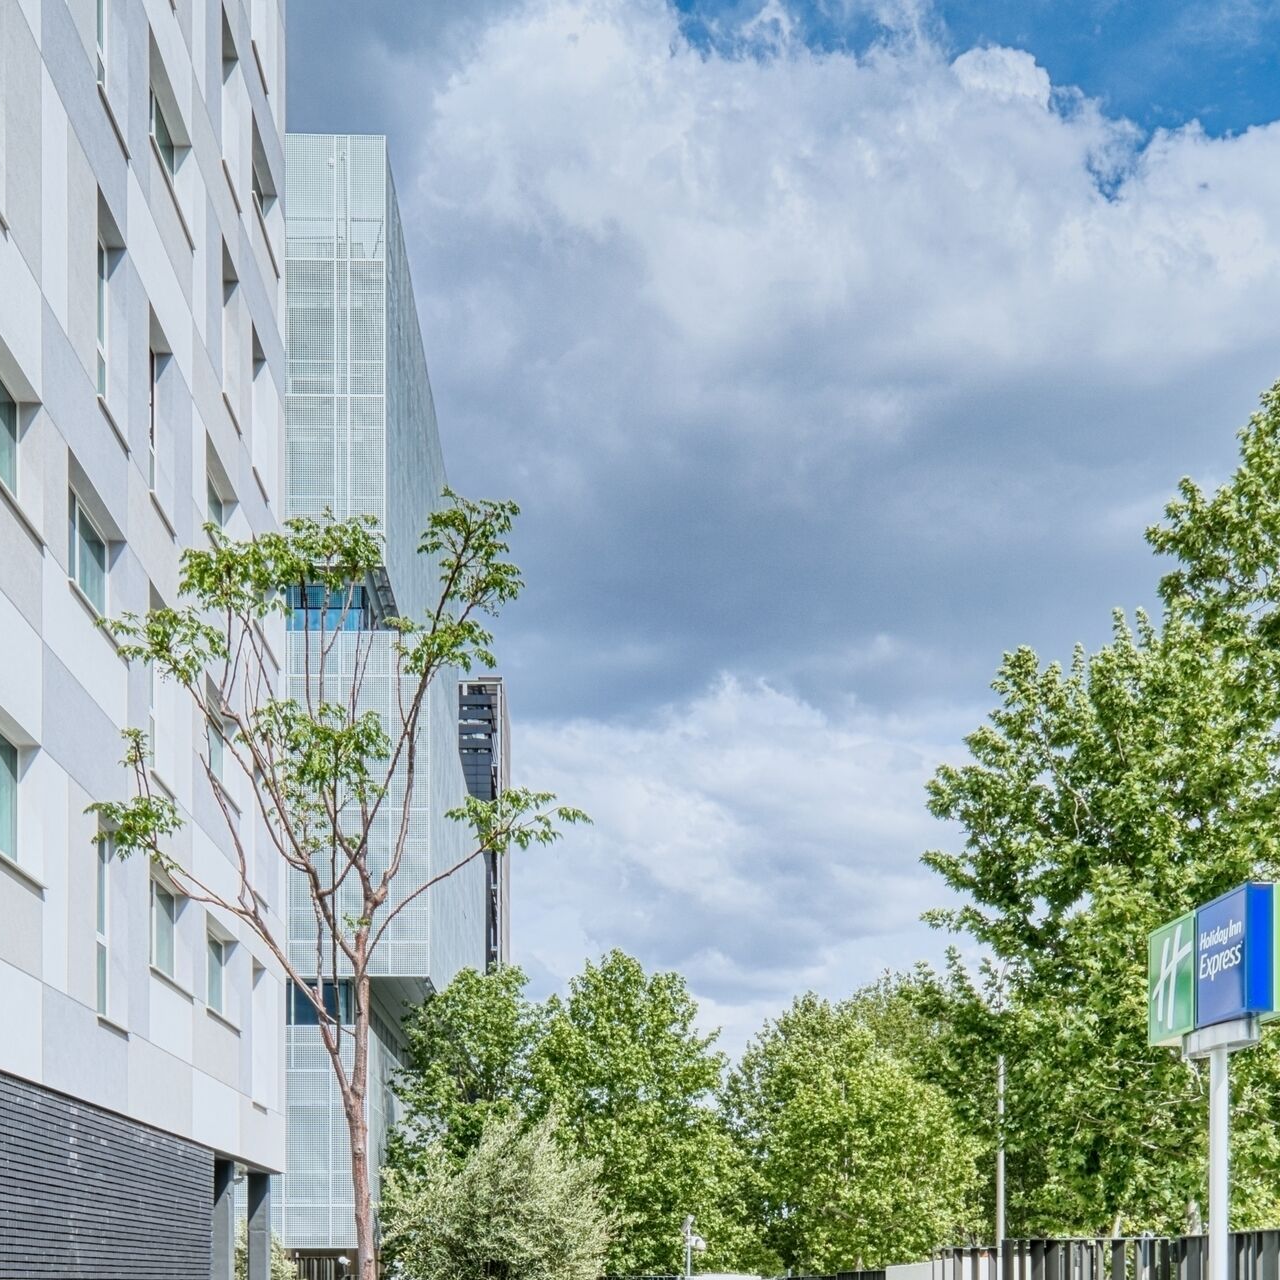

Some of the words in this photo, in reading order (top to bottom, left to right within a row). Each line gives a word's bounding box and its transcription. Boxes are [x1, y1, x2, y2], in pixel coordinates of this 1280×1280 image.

[1199, 926, 1229, 951] Holiday
[1229, 919, 1242, 938] Inn
[1199, 944, 1242, 982] Express
